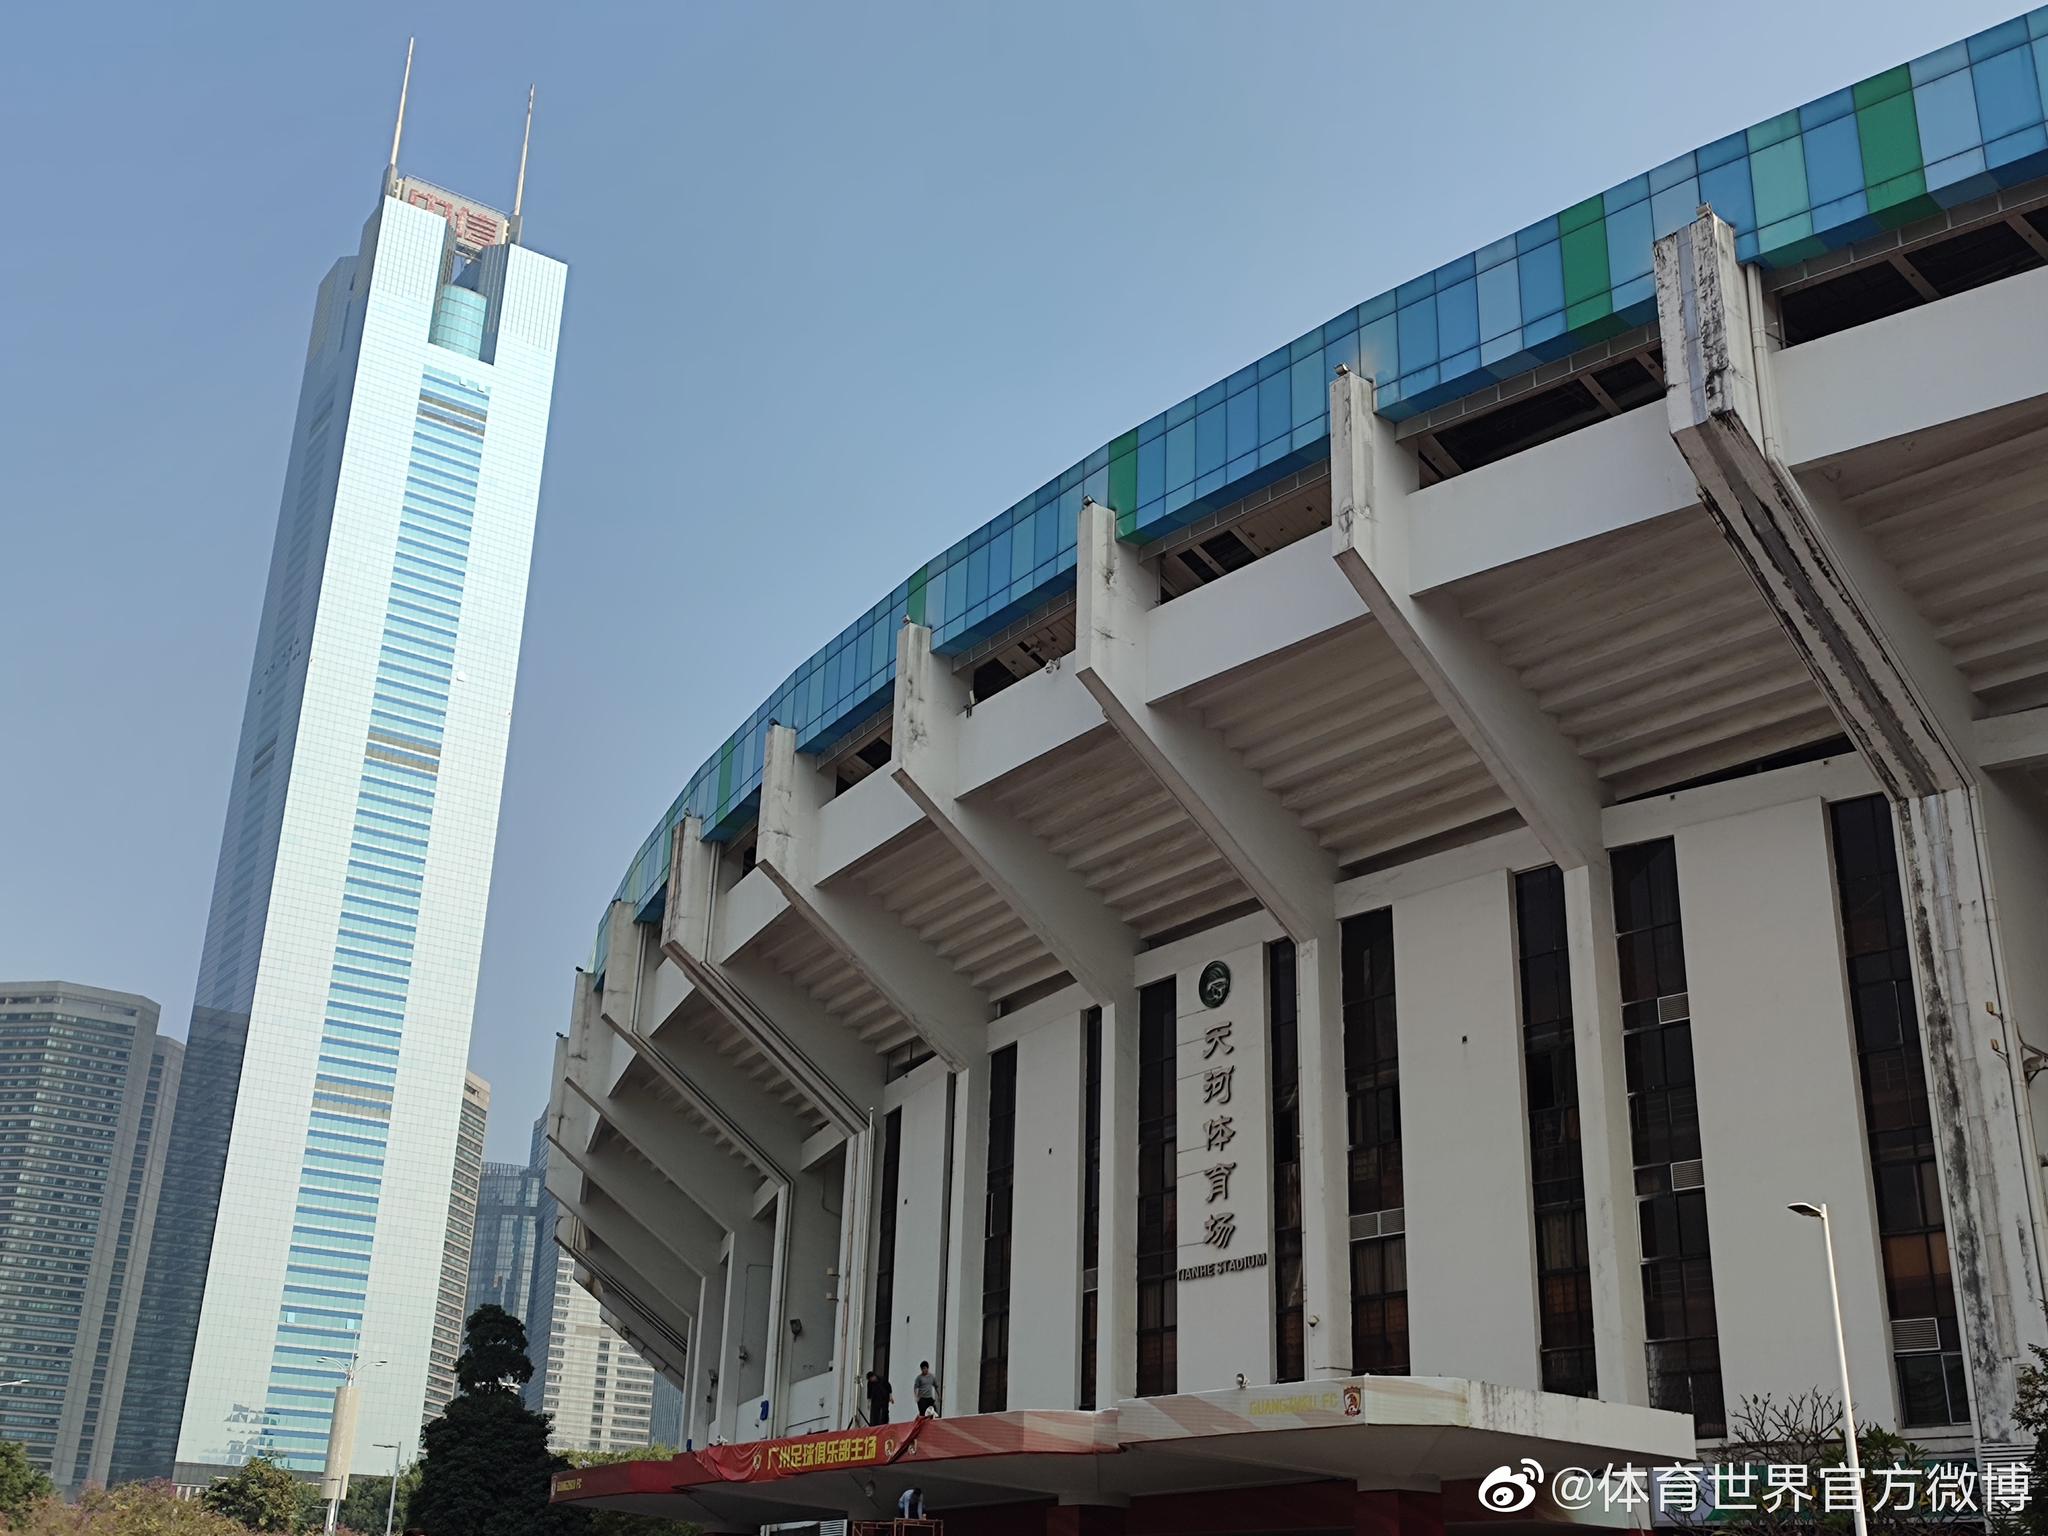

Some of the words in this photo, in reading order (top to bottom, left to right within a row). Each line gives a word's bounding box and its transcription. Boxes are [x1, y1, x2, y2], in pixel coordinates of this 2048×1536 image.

[1203, 1020, 1236, 1249] 天河体育场
[1177, 1263, 1216, 1281] TIANHE
[1217, 1252, 1267, 1276] STADIUM
[767, 1435, 877, 1471] 广州足球俱乐部主场
